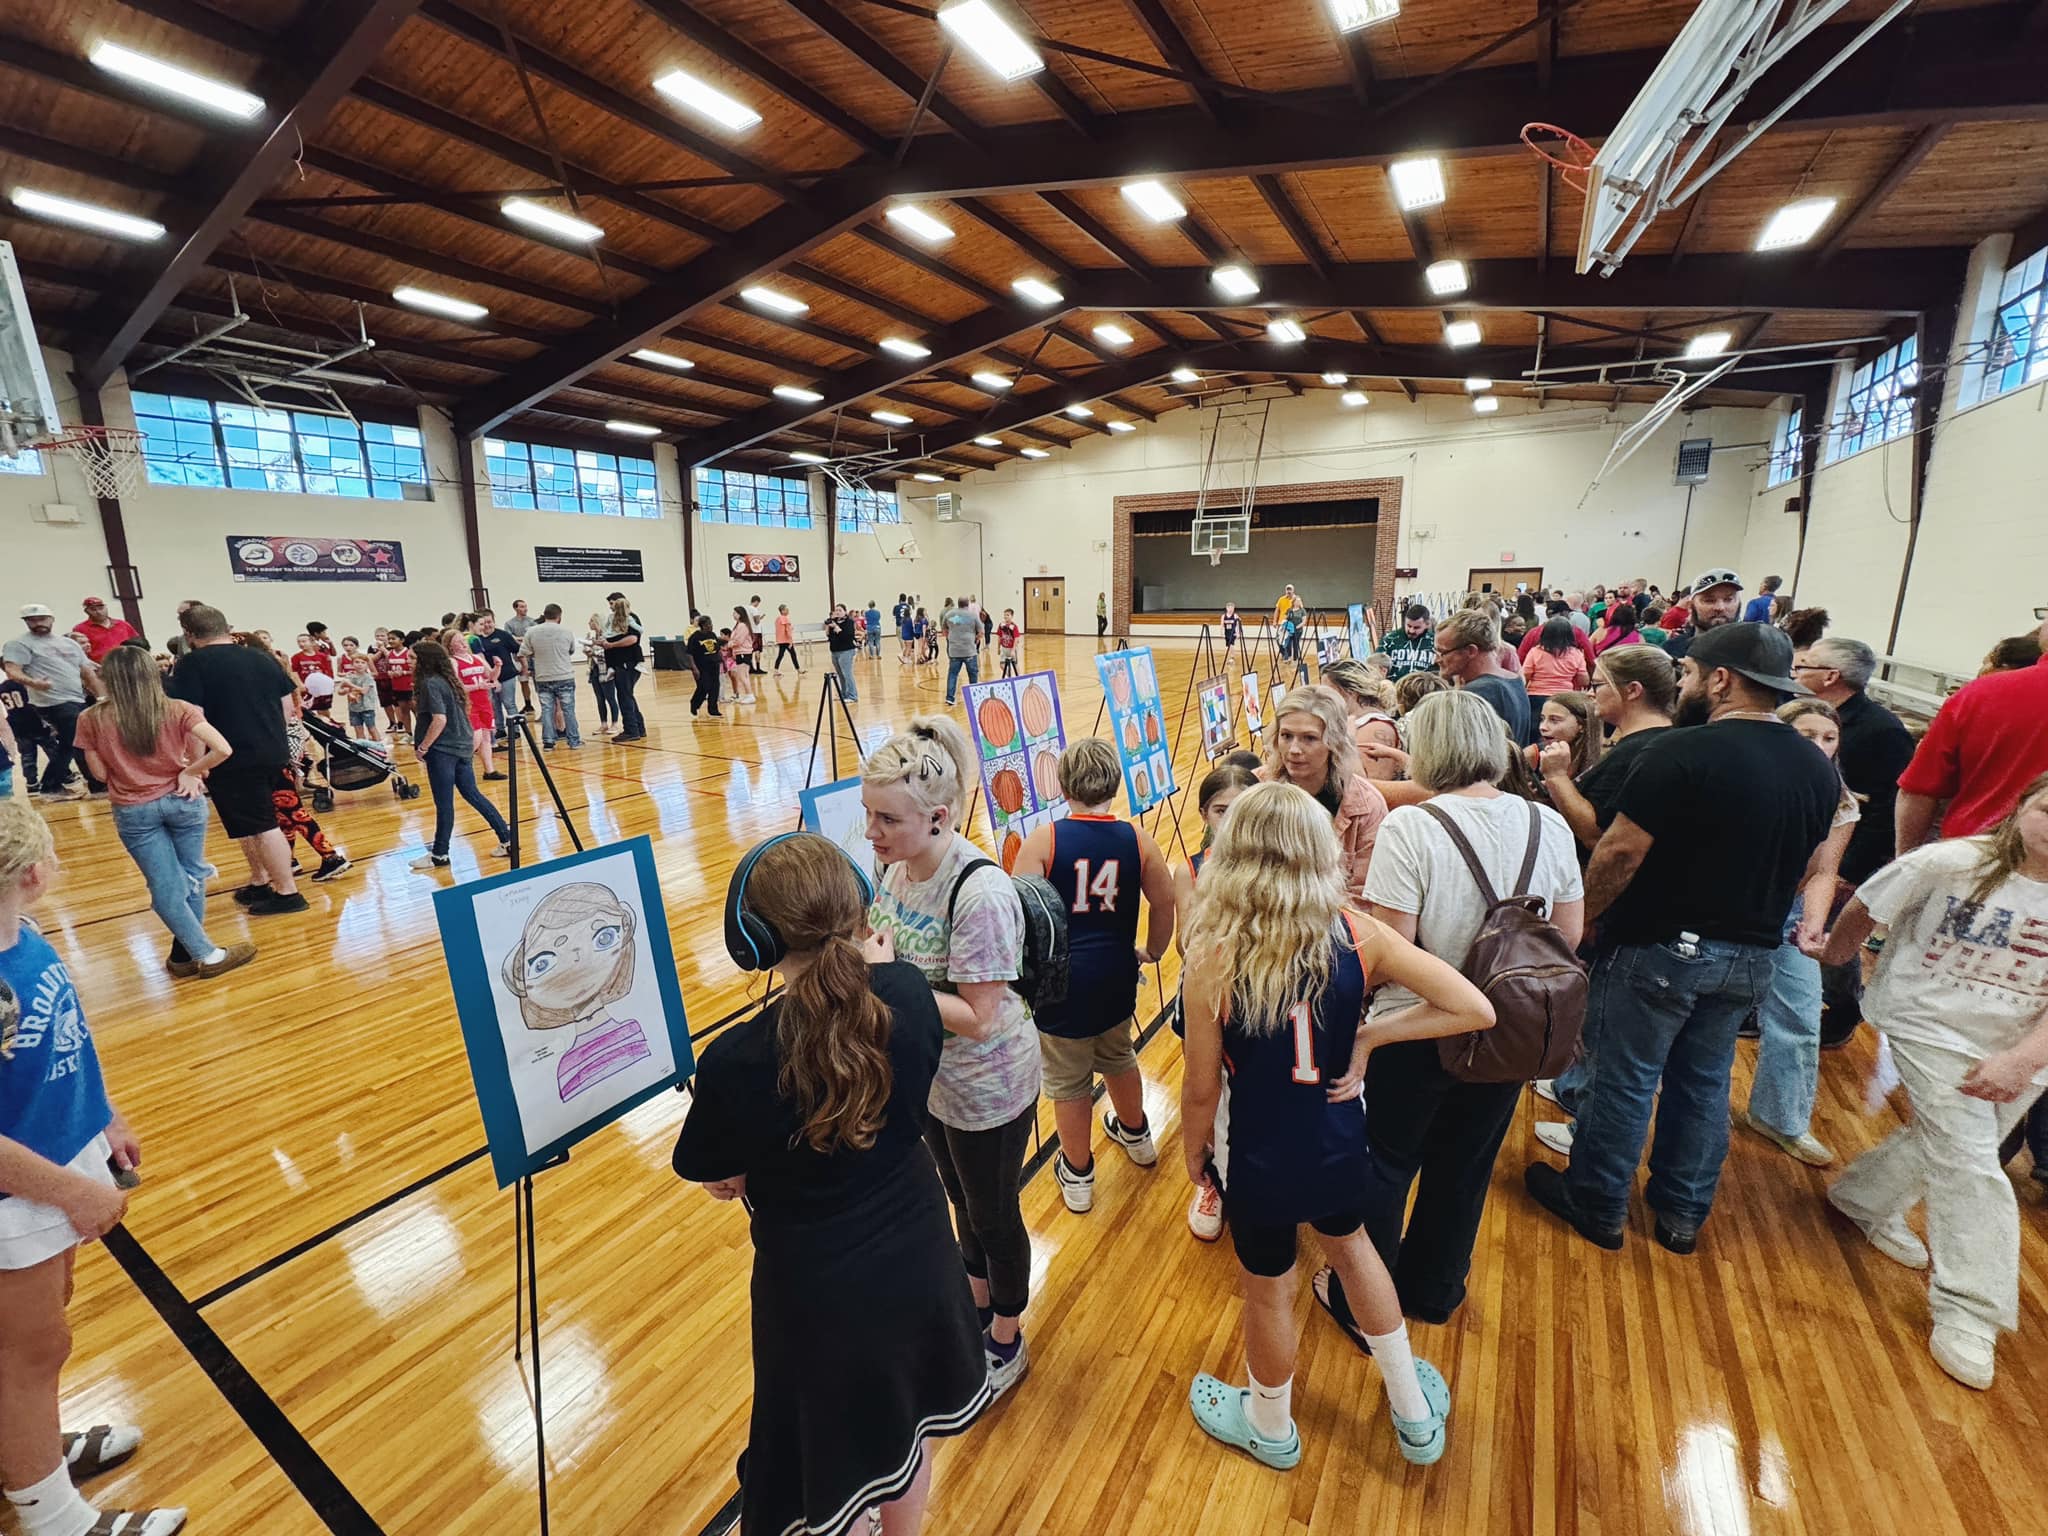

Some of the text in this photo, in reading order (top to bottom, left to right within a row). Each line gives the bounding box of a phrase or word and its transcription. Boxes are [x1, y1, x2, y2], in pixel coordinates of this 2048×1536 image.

[1391, 648, 1436, 665] COWAN
[0, 691, 24, 710] 30
[1071, 857, 1120, 914] 14
[1288, 1000, 1320, 1085] 1
